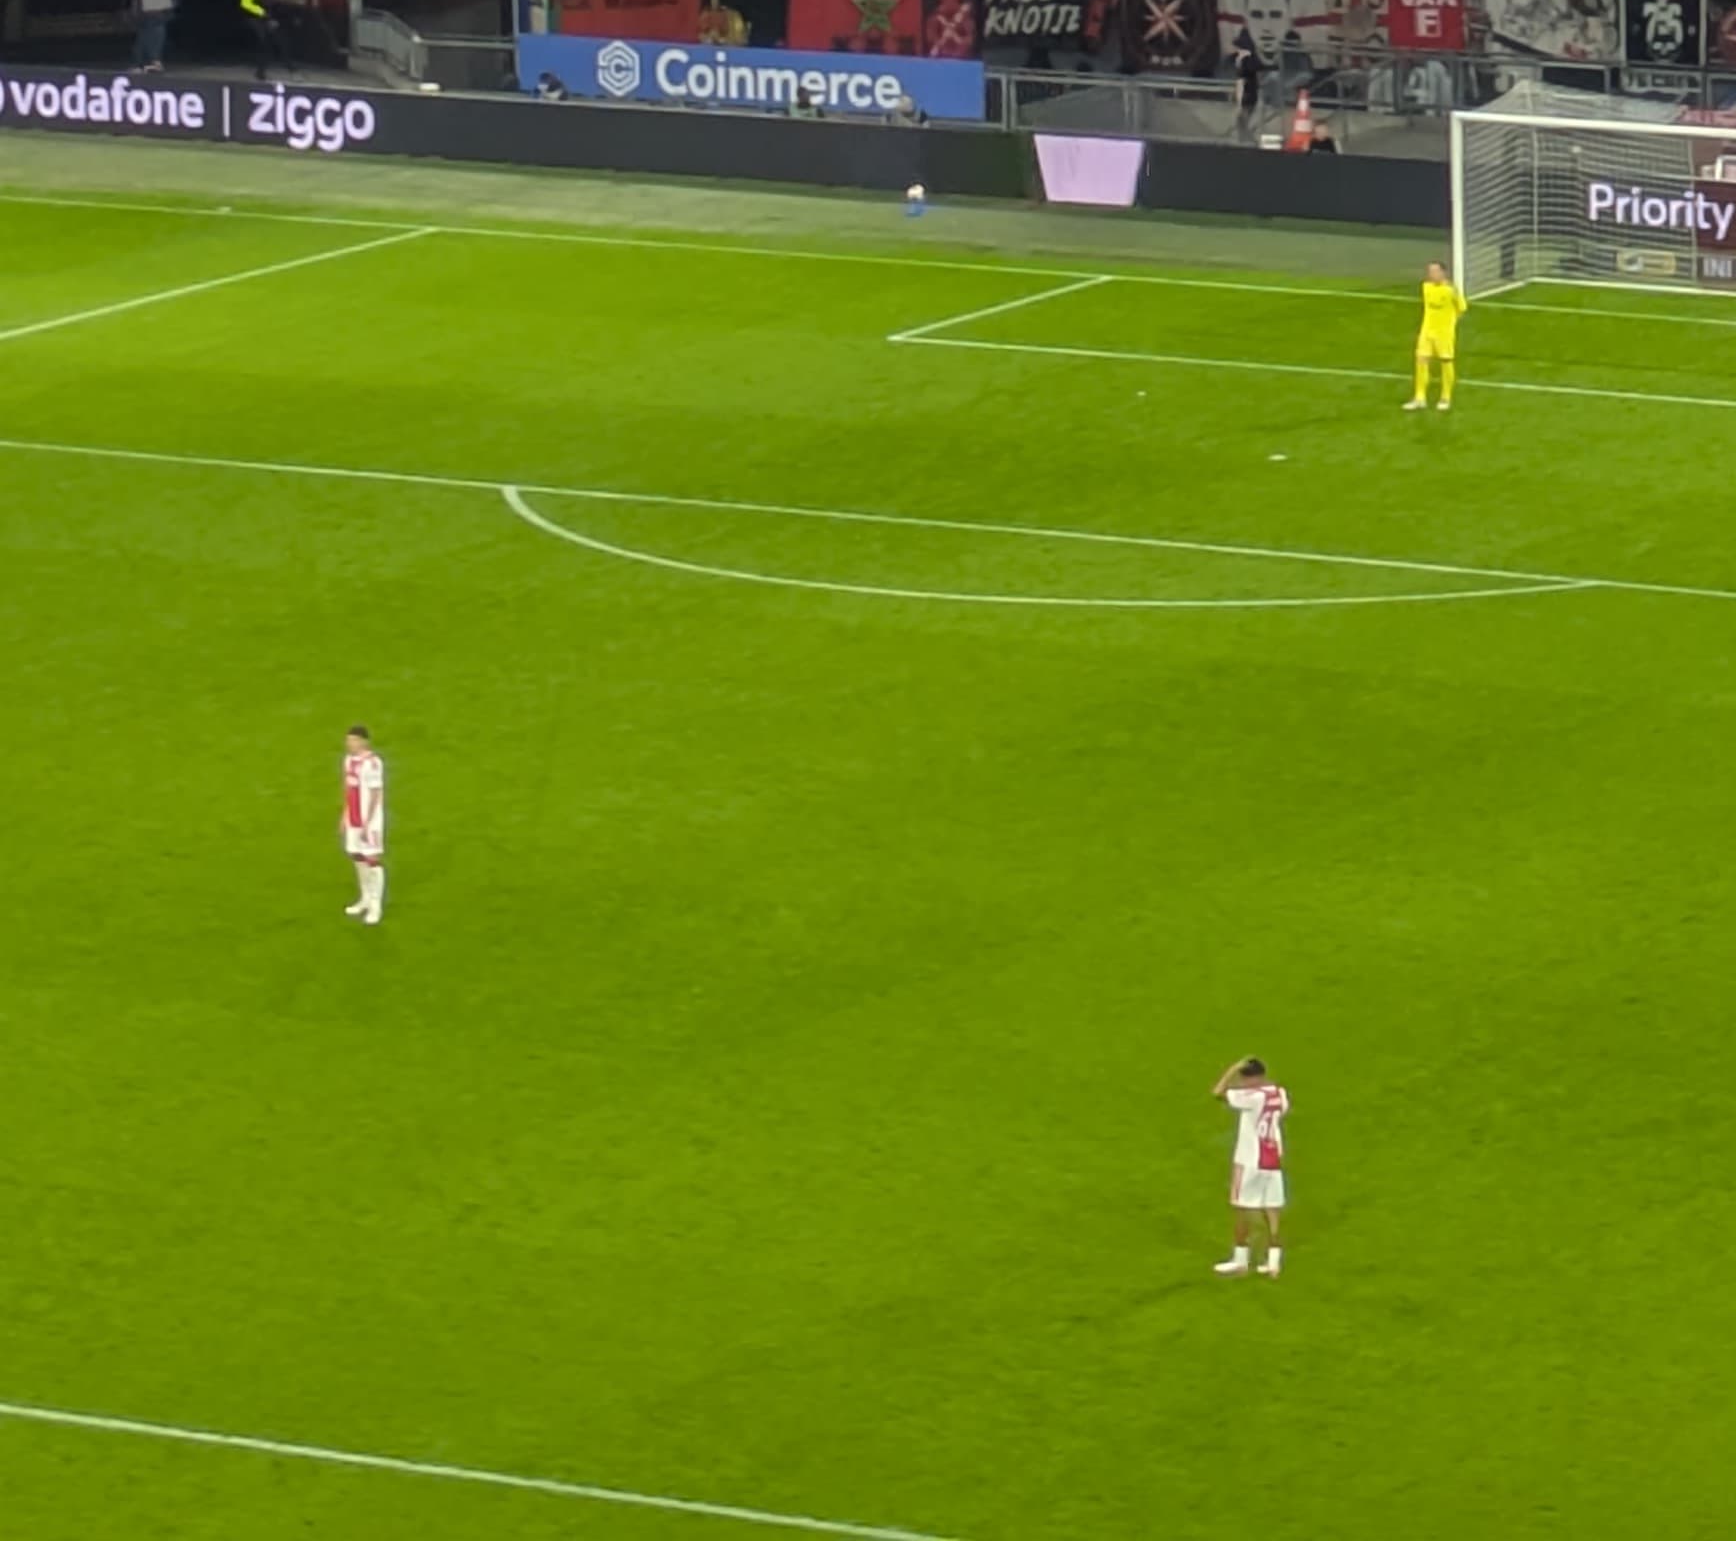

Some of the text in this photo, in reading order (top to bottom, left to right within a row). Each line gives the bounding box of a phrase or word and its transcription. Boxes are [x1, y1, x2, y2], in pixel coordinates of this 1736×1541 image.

[655, 48, 903, 110] Coinmerce
[8, 71, 377, 152] vodafone ziggo
[1588, 182, 1735, 242] Priority
